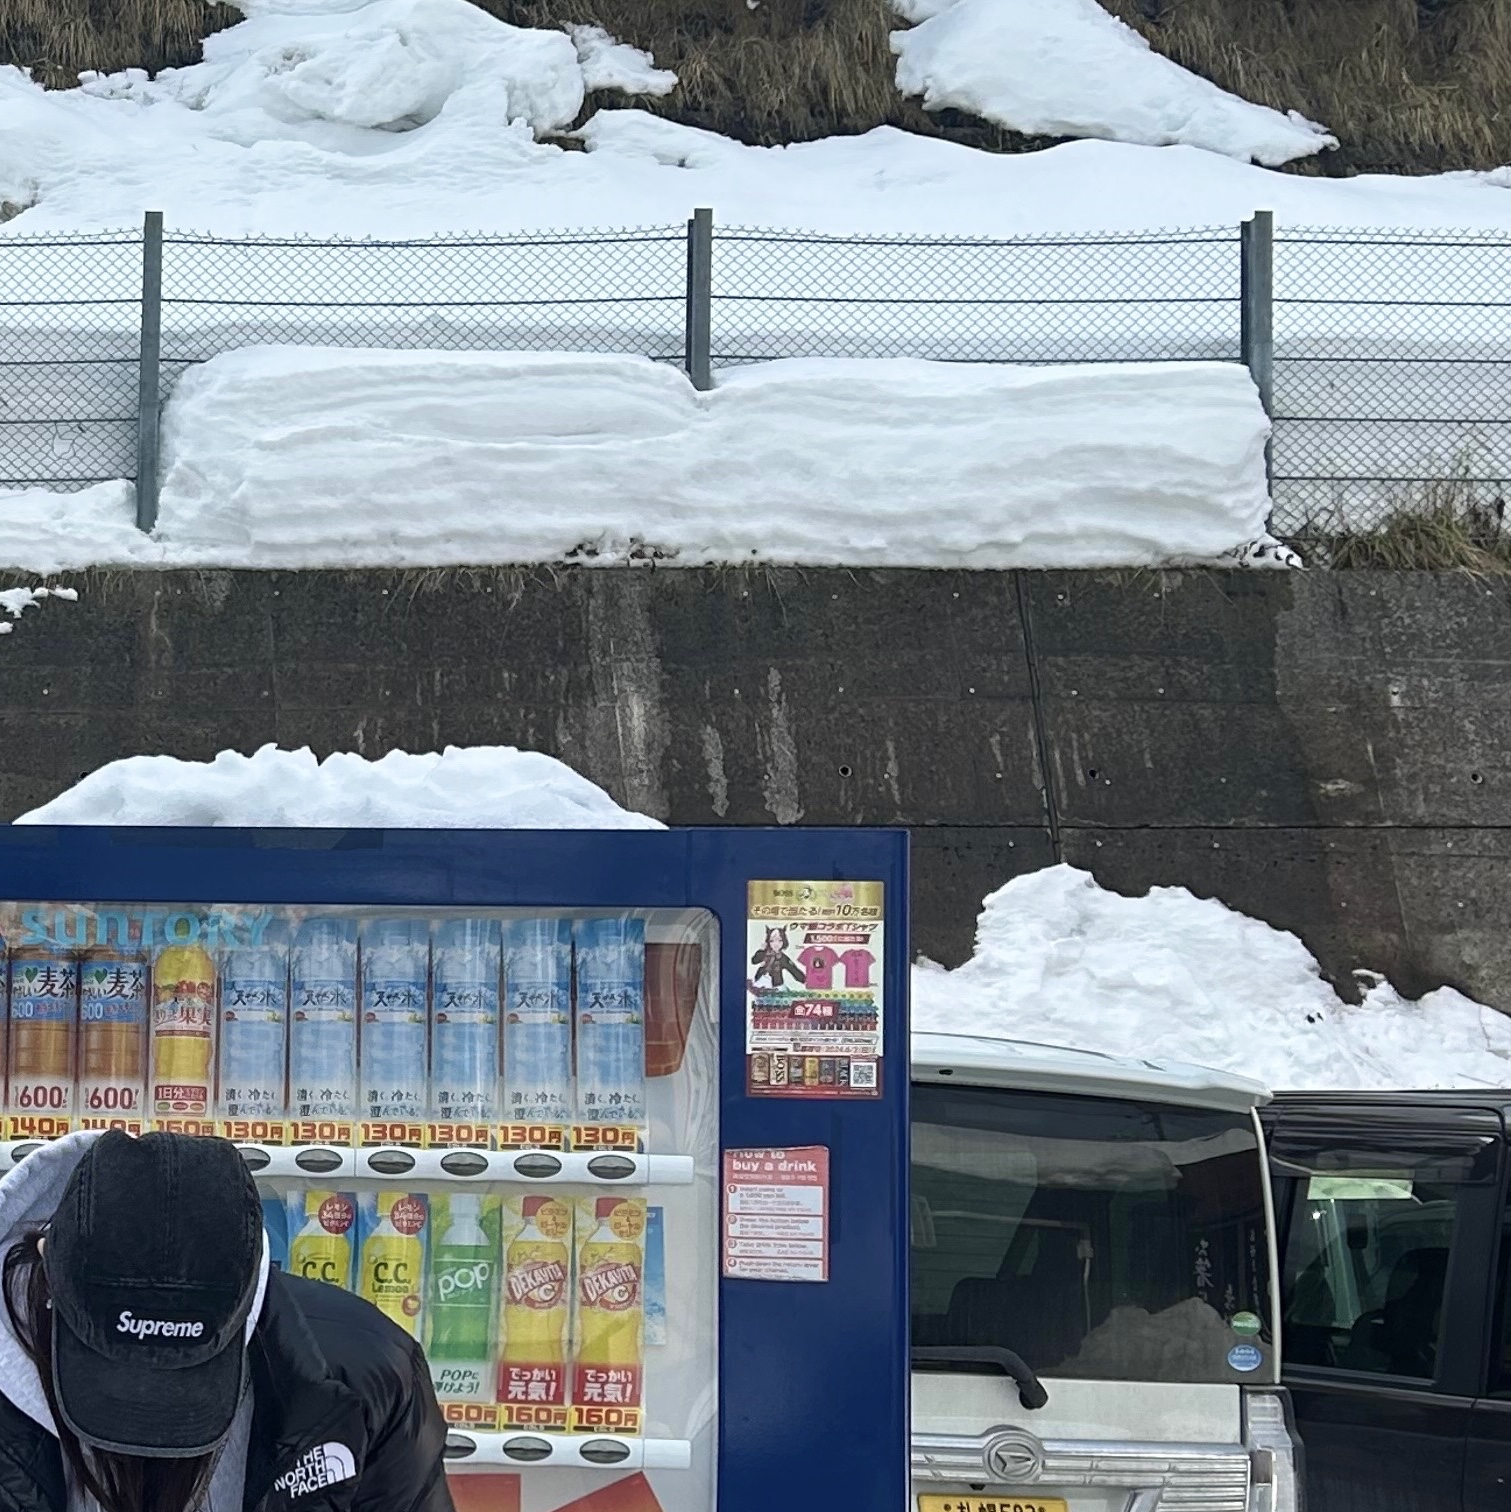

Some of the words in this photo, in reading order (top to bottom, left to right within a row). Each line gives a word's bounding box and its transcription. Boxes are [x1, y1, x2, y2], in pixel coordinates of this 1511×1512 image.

[21, 908, 275, 947] SUNTORY
[37, 966, 75, 998] 麦茶
[108, 968, 145, 1000] 麦茶
[19, 1085, 63, 1109] 600
[90, 1087, 133, 1110] 600
[10, 1116, 69, 1135] 140円
[224, 1121, 283, 1139] 130円
[290, 1122, 350, 1140] 130円
[361, 1123, 422, 1141] 130円
[428, 1125, 488, 1142] 130円
[500, 1126, 561, 1143] 130円
[572, 1127, 635, 1144] 130円
[770, 1151, 785, 1159] to
[732, 1159, 760, 1172] buy
[764, 1162, 774, 1172] a
[778, 1160, 817, 1172] drink
[302, 1262, 339, 1283] C.C.
[373, 1262, 412, 1284] C.C.
[438, 1262, 489, 1302] pop
[510, 1263, 564, 1301] DEKAVITA
[583, 1263, 637, 1302] DEKAVITA
[116, 1310, 204, 1340] Supreme
[509, 1367, 556, 1380] でっかい
[585, 1369, 632, 1382] でっかい
[508, 1381, 555, 1401] 元気!
[584, 1383, 632, 1402] 元気!
[506, 1406, 567, 1424] 160円
[574, 1408, 638, 1426] 160円
[296, 1445, 323, 1468] THE
[274, 1455, 326, 1492] NORTH
[290, 1472, 328, 1499] FACE
